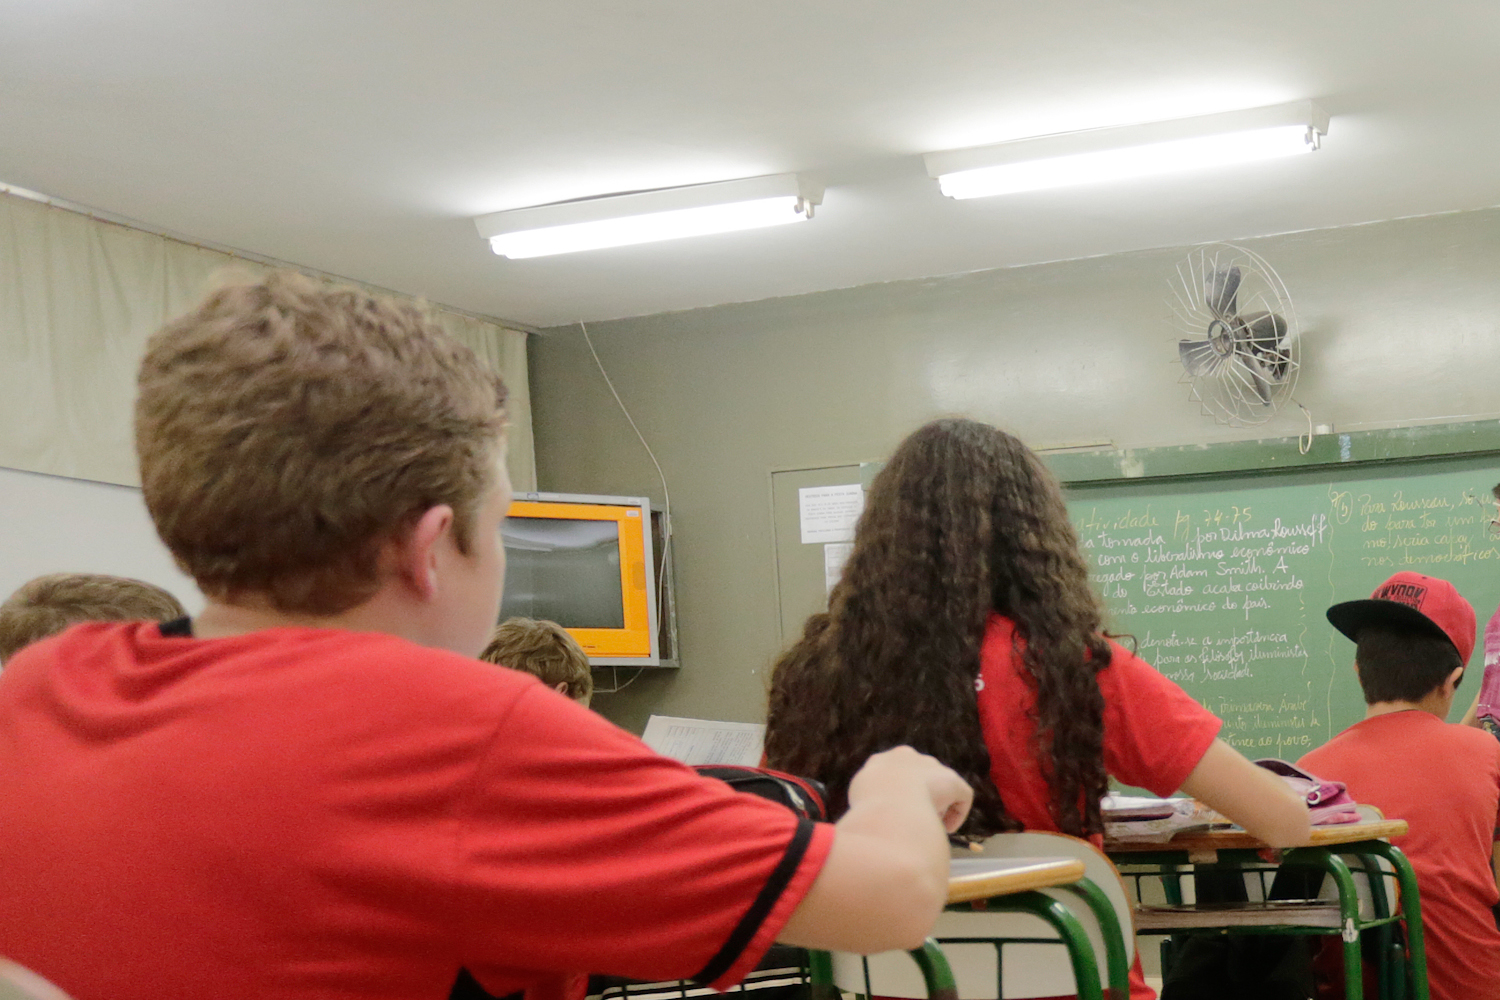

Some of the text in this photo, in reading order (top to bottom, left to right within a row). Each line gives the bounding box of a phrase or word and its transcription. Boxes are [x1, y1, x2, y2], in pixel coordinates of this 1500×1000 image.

[1358, 493, 1386, 516] Para
[1098, 531, 1166, 549] tomada
[1191, 527, 1217, 559] por
[1220, 521, 1270, 542] Dilma
[1098, 554, 1126, 566] com
[1131, 552, 1139, 563] o
[1361, 555, 1394, 567] nos
[1170, 563, 1208, 579] Adam
[1216, 556, 1265, 576] Smith.
[1273, 555, 1288, 574] A
[1203, 576, 1242, 594] acaba
[1245, 574, 1304, 591] coibindo
[1222, 596, 1237, 610] do
[1202, 636, 1213, 646] a
[1258, 737, 1272, 747] ao
